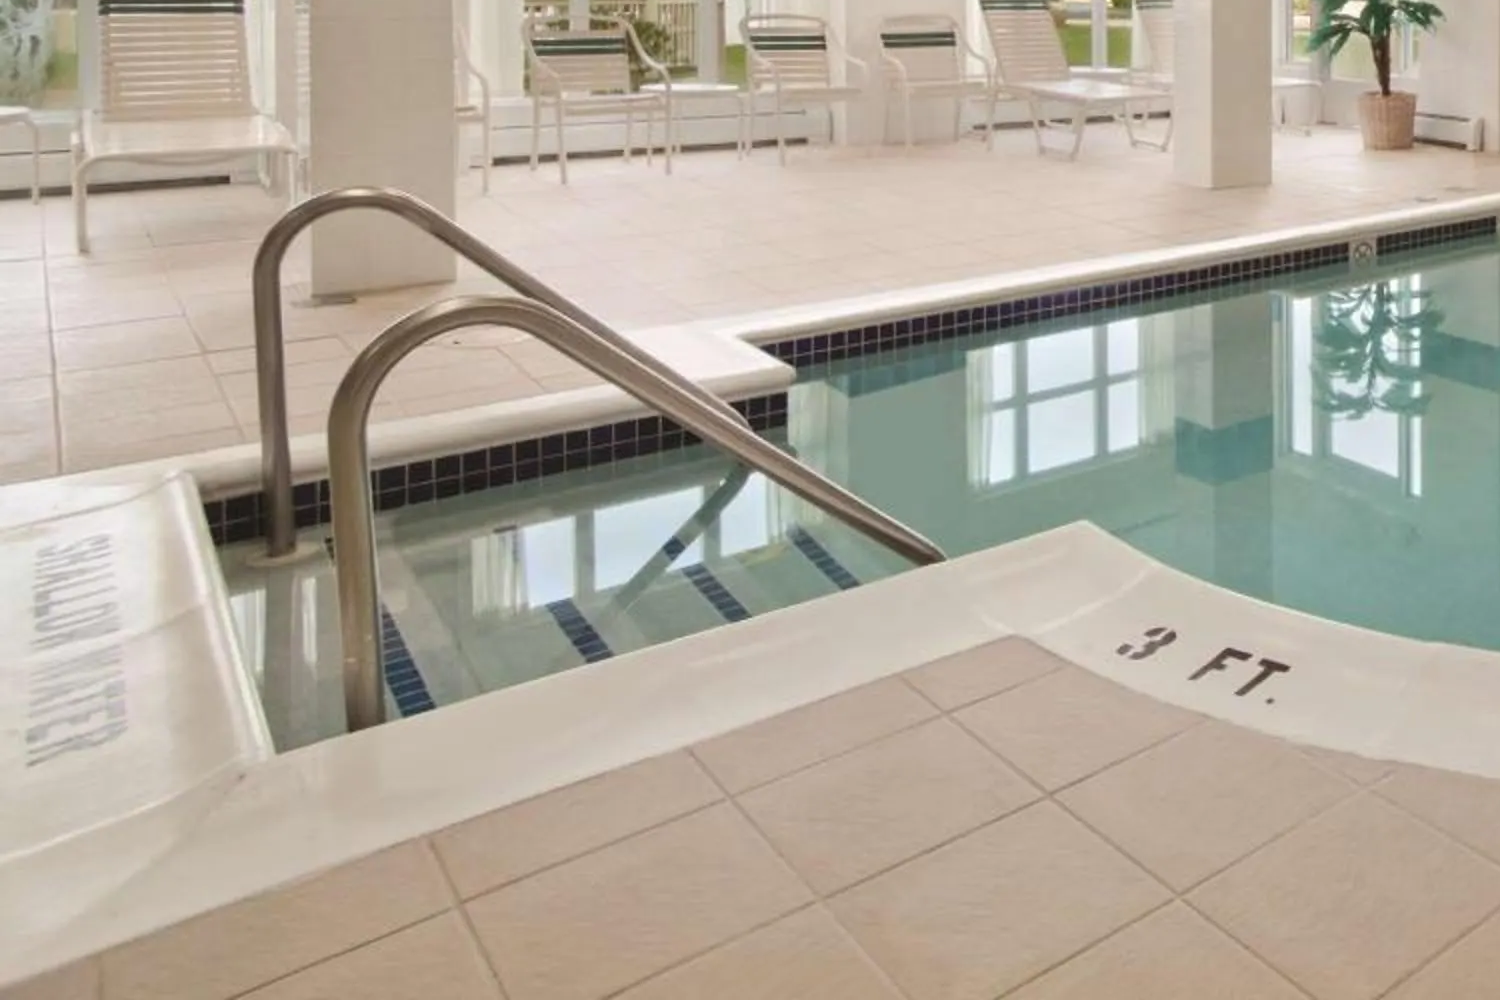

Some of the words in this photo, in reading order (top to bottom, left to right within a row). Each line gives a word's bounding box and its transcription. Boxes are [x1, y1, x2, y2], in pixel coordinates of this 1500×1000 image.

[31, 534, 121, 650] SHALLOW
[25, 644, 128, 767] WATER
[1116, 627, 1177, 660] 3
[1187, 647, 1291, 705] FT.
